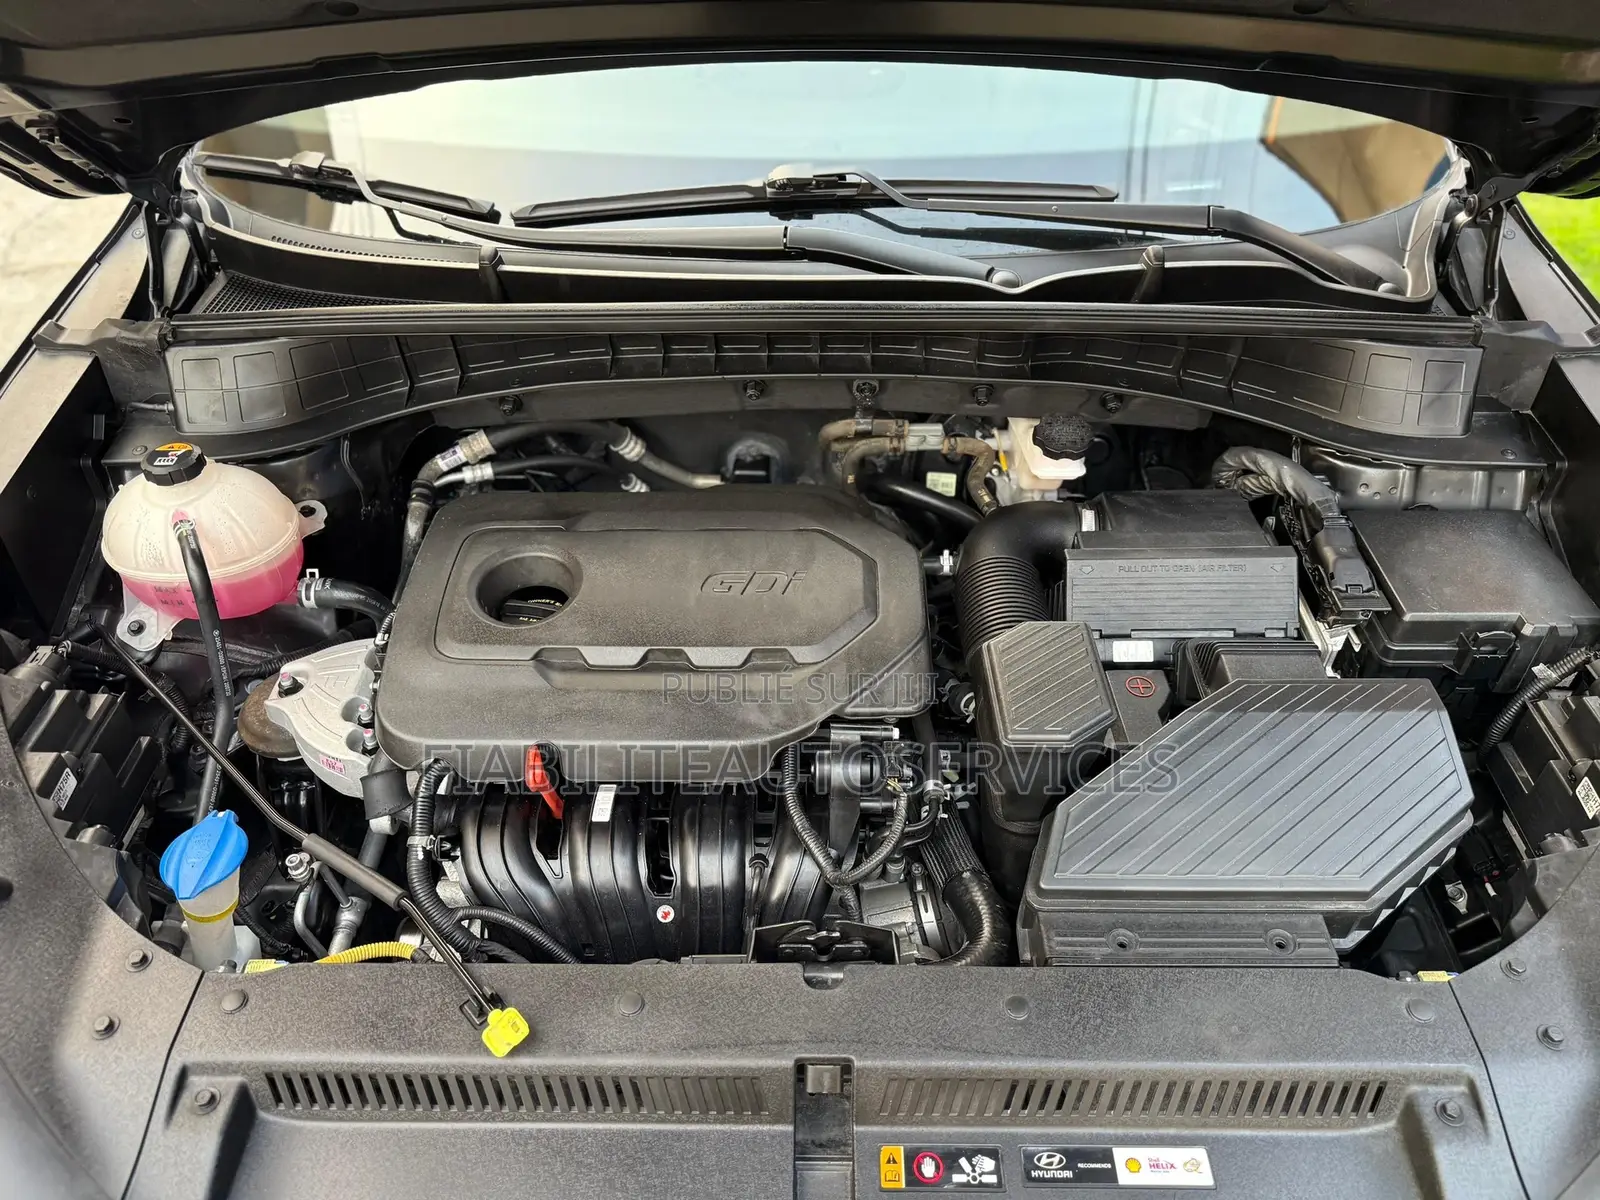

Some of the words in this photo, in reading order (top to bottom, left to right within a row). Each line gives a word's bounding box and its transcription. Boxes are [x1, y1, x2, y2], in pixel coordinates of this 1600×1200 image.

[1118, 565, 1139, 573] PULL
[1141, 565, 1157, 573] OUT
[1160, 564, 1171, 573] TO
[1173, 564, 1196, 573] OPEN
[1031, 1170, 1073, 1179] HYUNDAI
